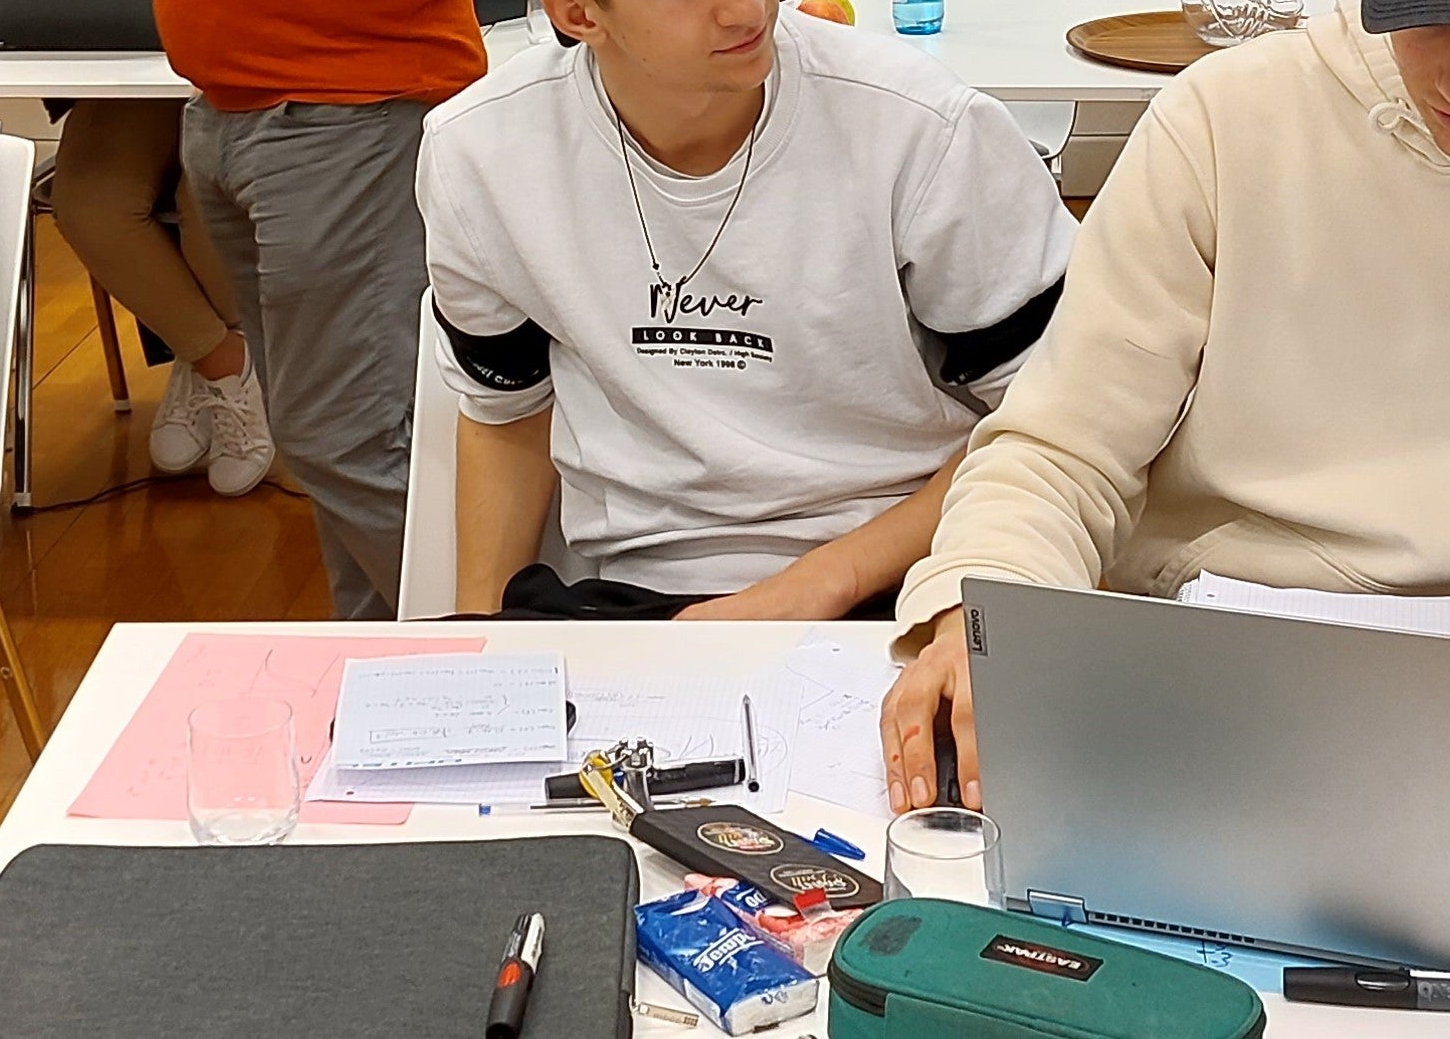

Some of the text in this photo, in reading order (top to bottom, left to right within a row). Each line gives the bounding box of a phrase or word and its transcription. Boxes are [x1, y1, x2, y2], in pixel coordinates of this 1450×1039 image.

[650, 276, 763, 324] Never
[643, 330, 765, 348] LOOK BACK
[673, 359, 693, 367] New
[695, 359, 714, 368] York
[970, 608, 983, 652] Lenovo
[997, 943, 1082, 970] EASTPAK
